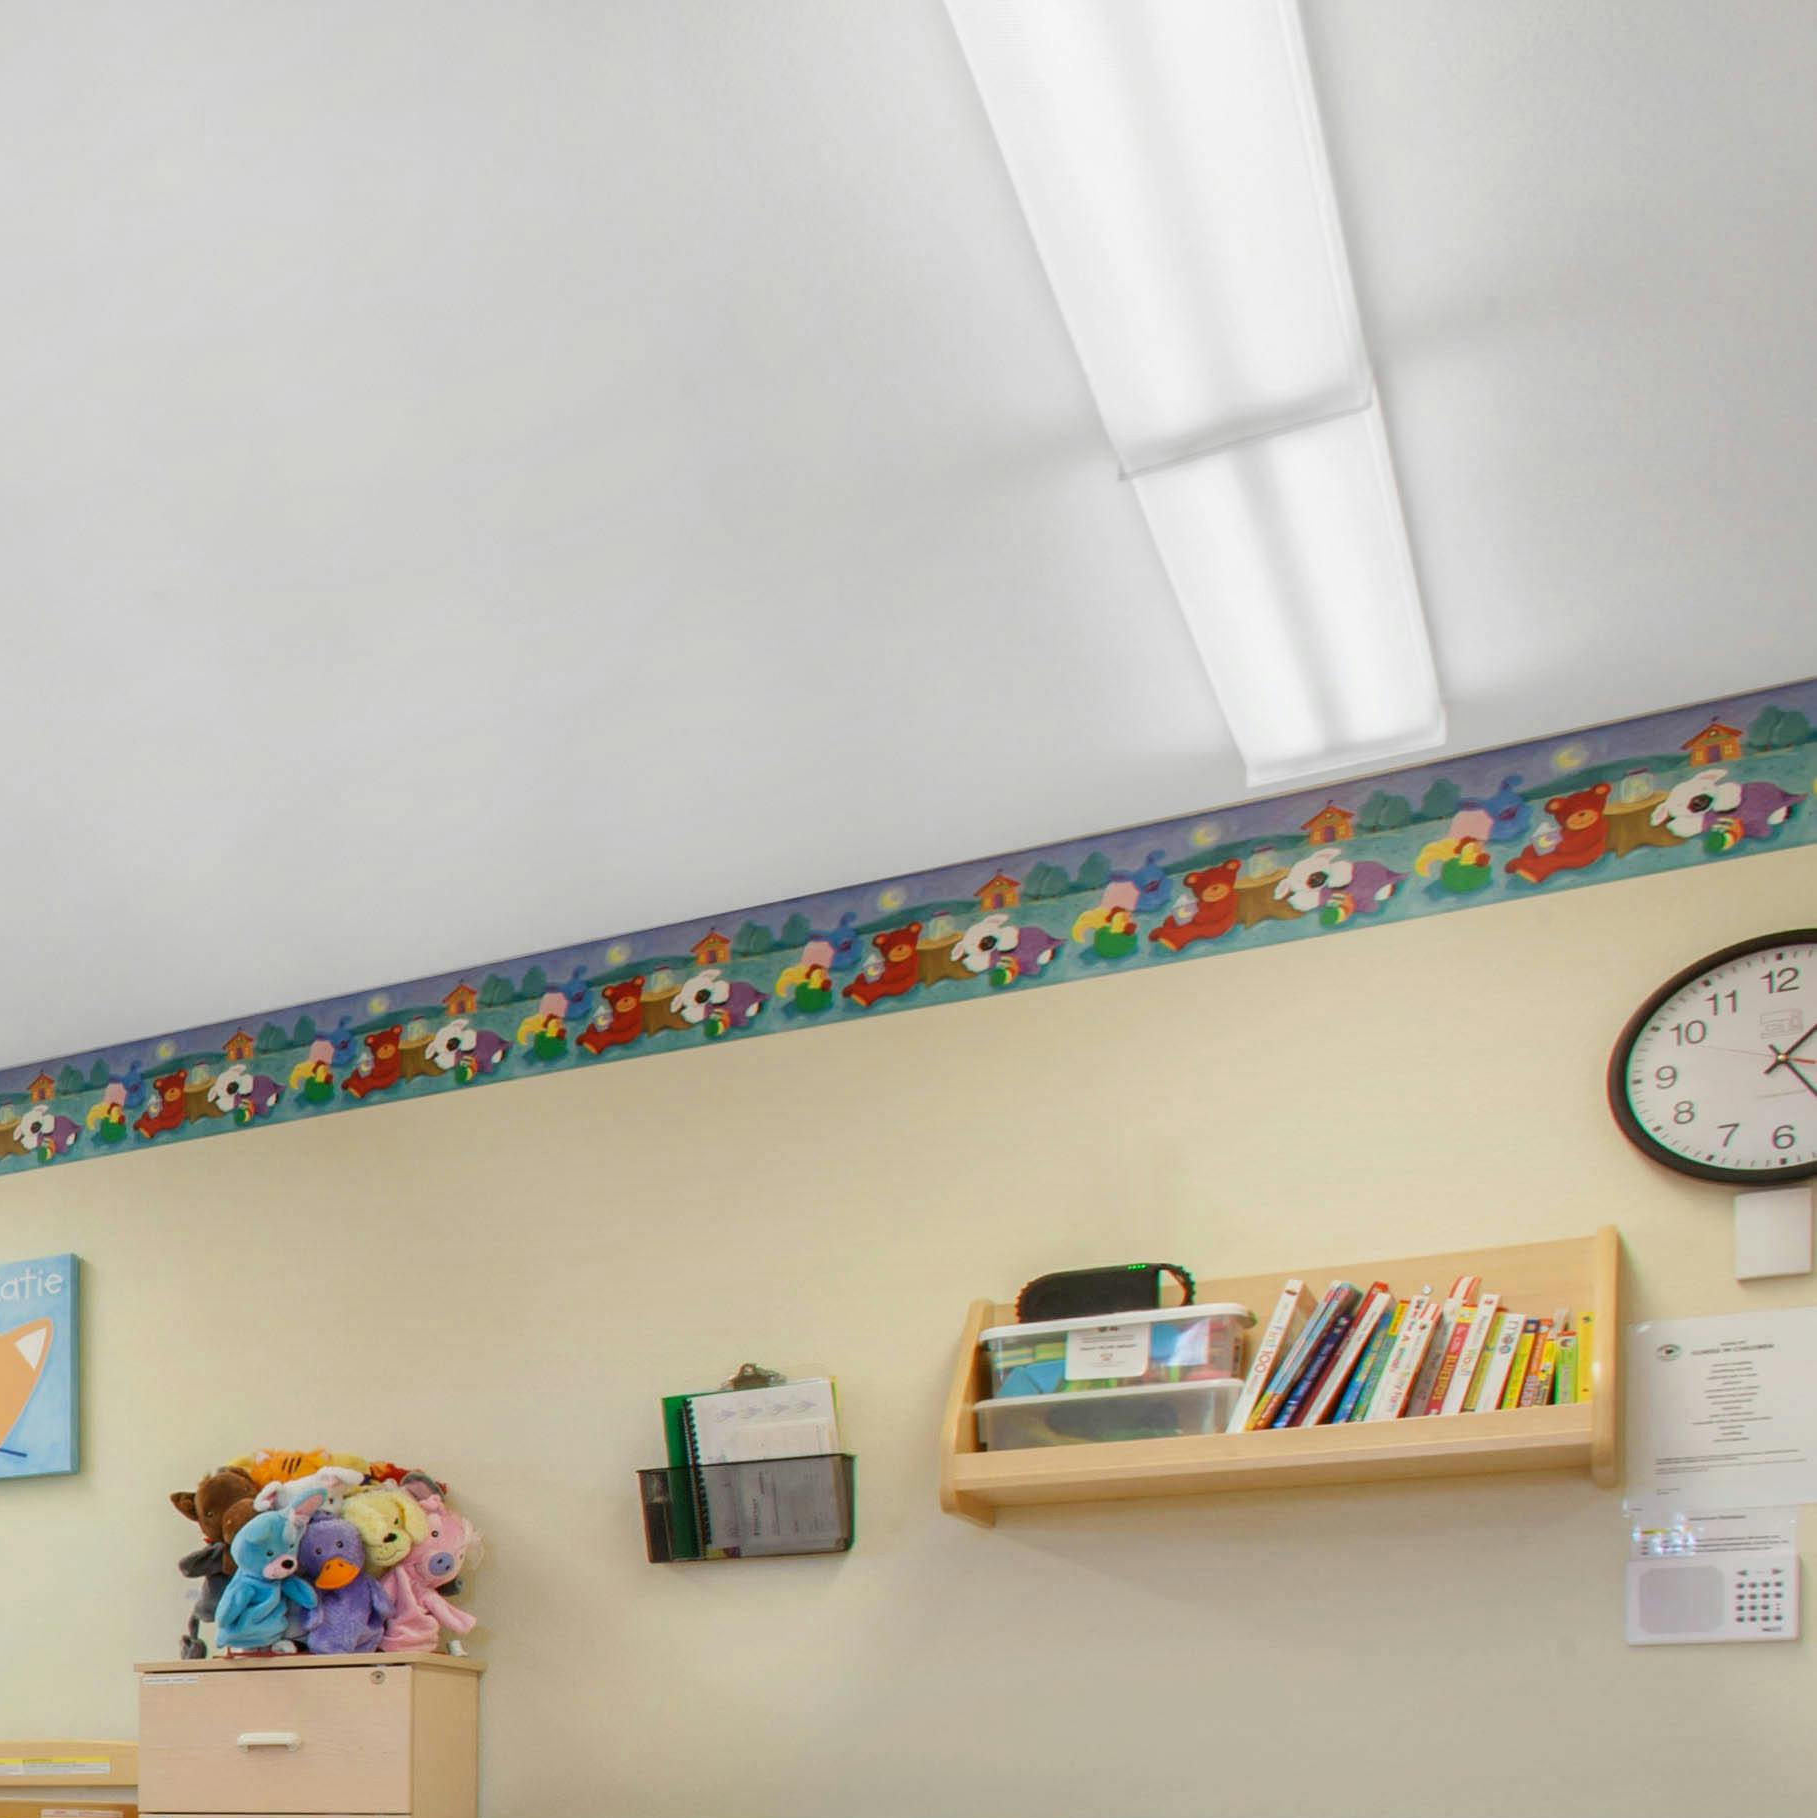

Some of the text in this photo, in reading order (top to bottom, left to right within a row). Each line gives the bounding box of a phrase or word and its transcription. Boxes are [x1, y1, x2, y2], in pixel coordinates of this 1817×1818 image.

[1761, 967, 1800, 994] 12
[1705, 990, 1738, 1016] 11
[1670, 1020, 1707, 1046] 10
[1654, 1065, 1678, 1090] 9
[1673, 1100, 1695, 1125] 8
[1717, 1123, 1740, 1147] 7
[1771, 1124, 1796, 1150] 6
